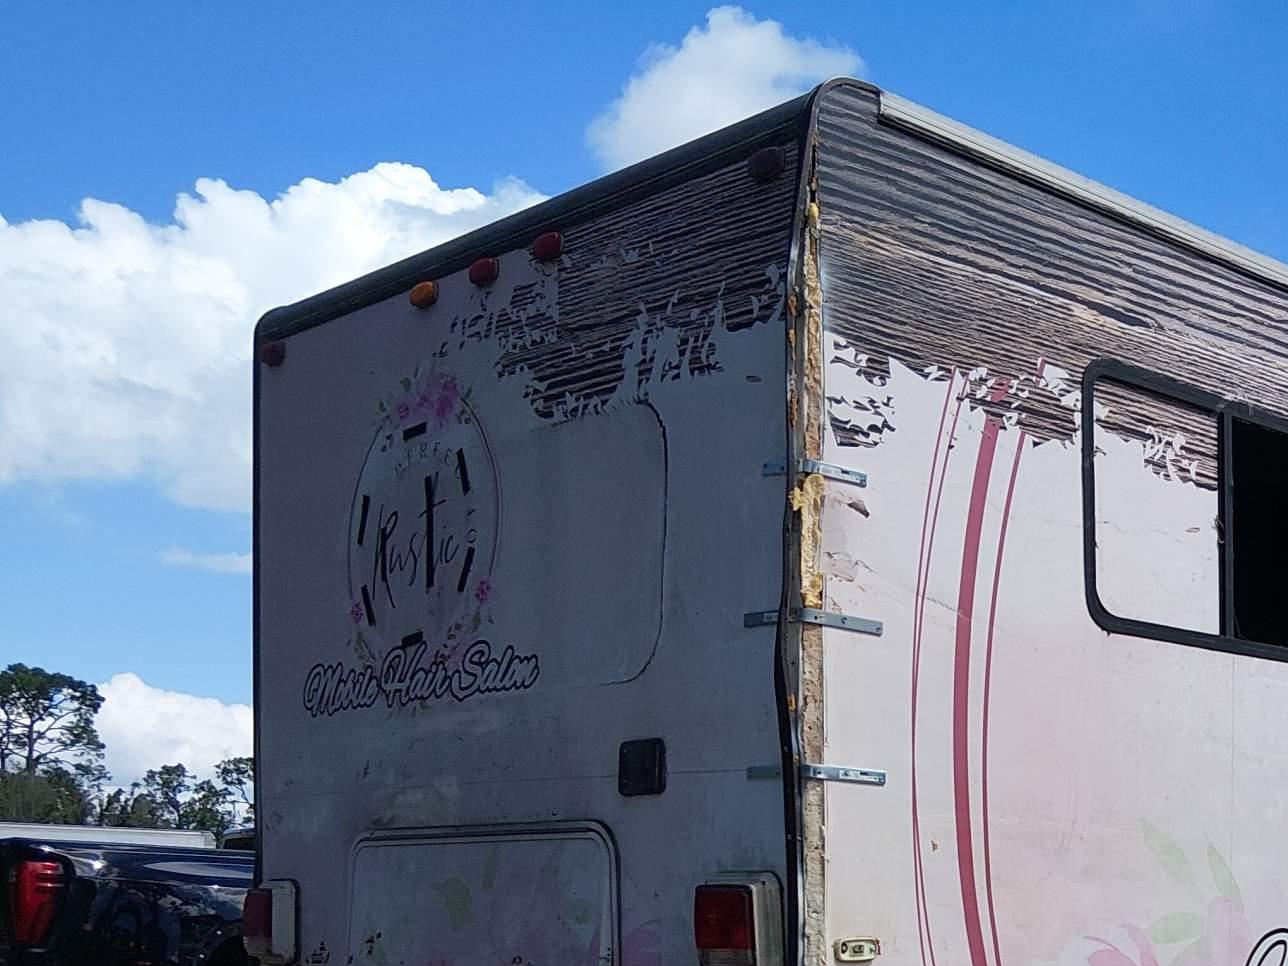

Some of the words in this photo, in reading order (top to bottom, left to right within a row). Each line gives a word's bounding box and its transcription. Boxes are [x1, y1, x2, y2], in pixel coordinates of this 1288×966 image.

[303, 661, 379, 718] Mobile
[379, 640, 450, 708] Hair
[449, 639, 540, 703] Salon
